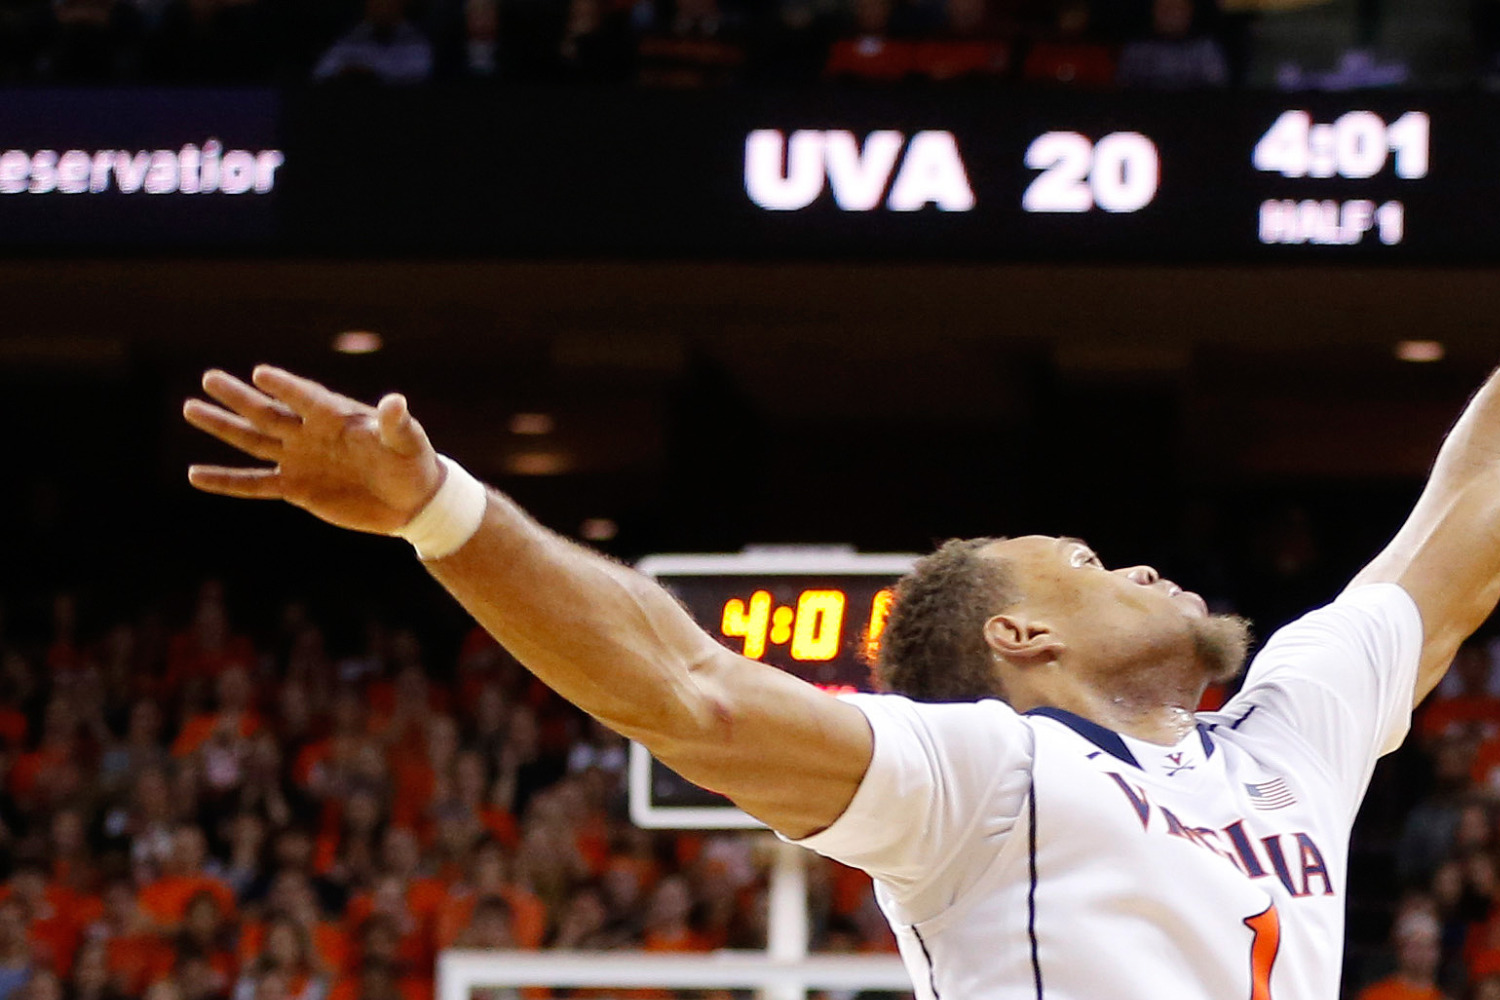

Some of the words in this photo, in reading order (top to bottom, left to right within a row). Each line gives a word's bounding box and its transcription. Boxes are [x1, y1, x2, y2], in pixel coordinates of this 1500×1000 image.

[745, 129, 975, 212] UVA
[1021, 132, 1161, 213] 20
[1253, 110, 1430, 180] 4:01
[1258, 200, 1375, 245] HALF
[1378, 200, 1403, 244] 1
